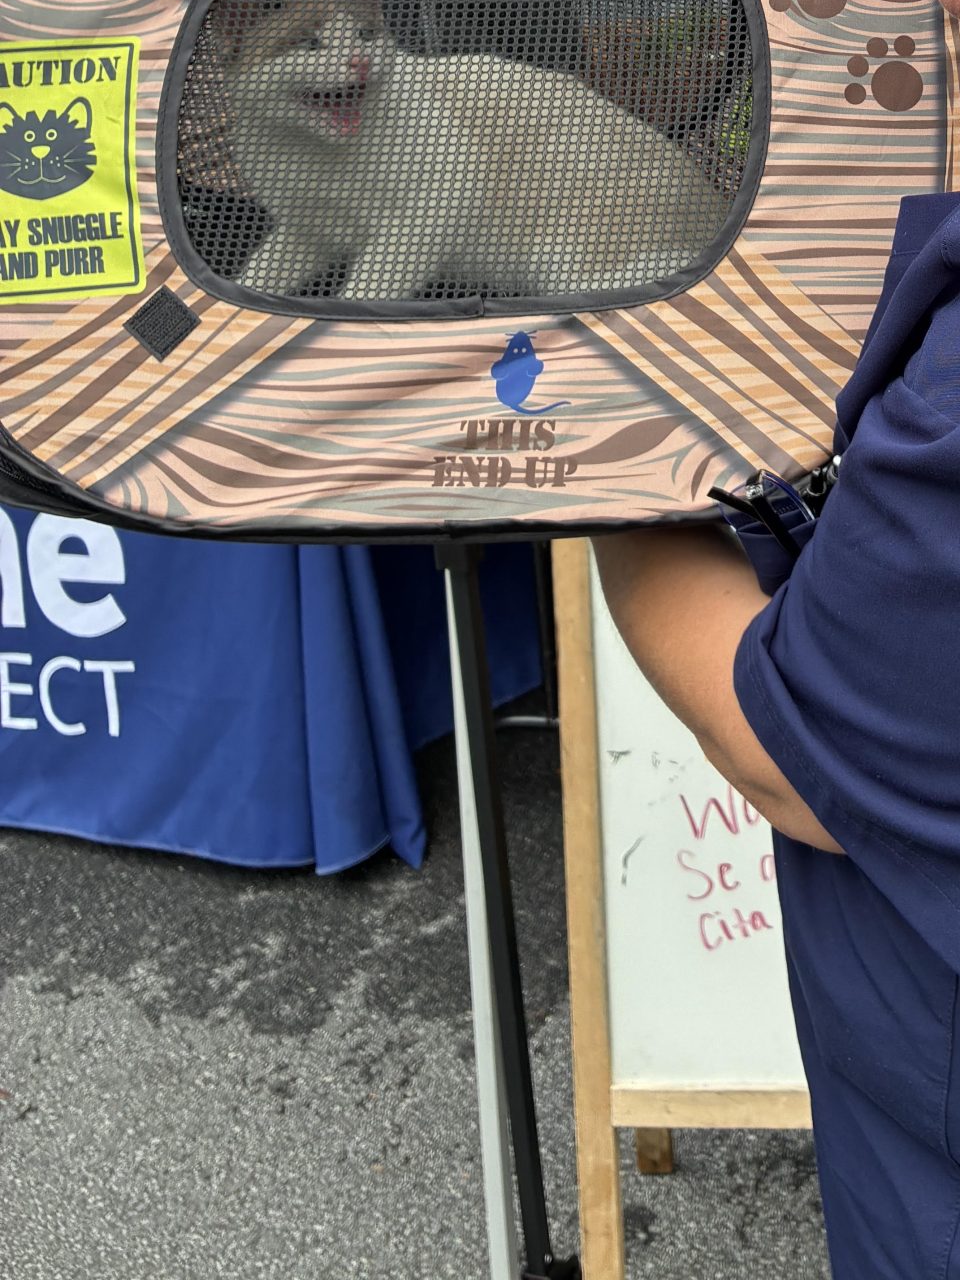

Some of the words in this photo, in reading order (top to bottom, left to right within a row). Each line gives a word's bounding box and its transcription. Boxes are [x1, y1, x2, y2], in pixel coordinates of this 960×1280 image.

[27, 211, 124, 246] SNUGGLE
[44, 246, 105, 278] PURR
[459, 419, 556, 452] THIS
[431, 456, 512, 488] END
[524, 456, 578, 488] UP
[676, 848, 741, 901] Se
